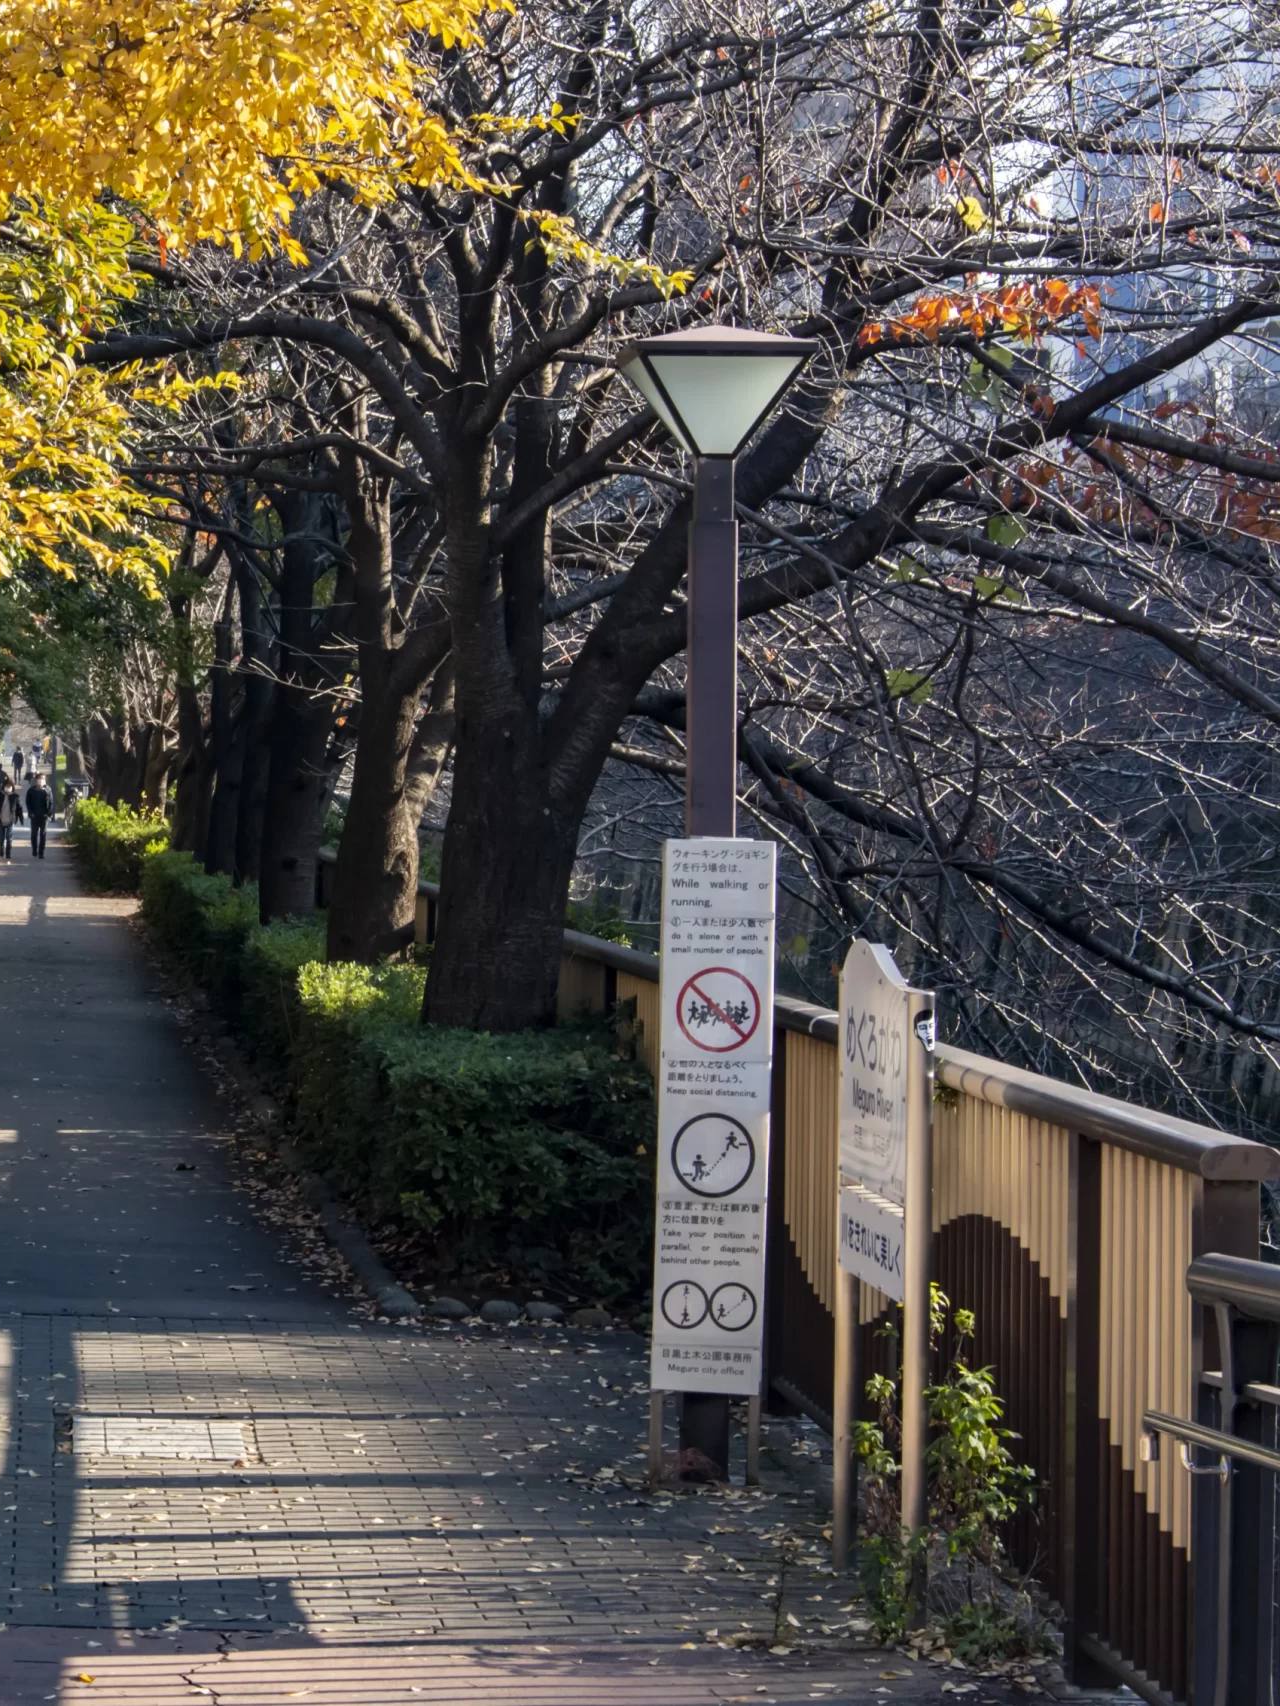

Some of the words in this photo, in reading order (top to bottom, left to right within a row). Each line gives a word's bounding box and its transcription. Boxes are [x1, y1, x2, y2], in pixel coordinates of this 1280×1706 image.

[672, 849, 770, 860] ウォーキング・ジョギン
[671, 879, 700, 889] While
[710, 879, 748, 891] walking
[758, 882, 770, 890] or
[671, 932, 681, 940] do
[687, 932, 693, 940] it
[699, 933, 721, 941] alone
[741, 933, 758, 942] with
[671, 945, 692, 953] small
[693, 946, 723, 954] number
[726, 946, 735, 954] of
[846, 1006, 902, 1079] めぐろがわ
[666, 1086, 687, 1096] Keep
[689, 1087, 713, 1096] social
[852, 1077, 875, 1119] Meguro
[876, 1087, 894, 1122] River
[662, 1214, 725, 1226] 方に位置取りを
[662, 1228, 682, 1237] Take
[688, 1231, 707, 1239] your
[713, 1231, 746, 1239] position
[752, 1232, 760, 1240] in
[720, 1245, 759, 1255] diagonally
[841, 1212, 901, 1277] 川をきれいに美しく
[660, 1256, 687, 1264] behind
[689, 1257, 711, 1265] other
[662, 1348, 753, 1363] 目黒土木公園事務所
[667, 1363, 699, 1374] Meguro
[701, 1365, 718, 1375] city
[720, 1366, 745, 1376] office
